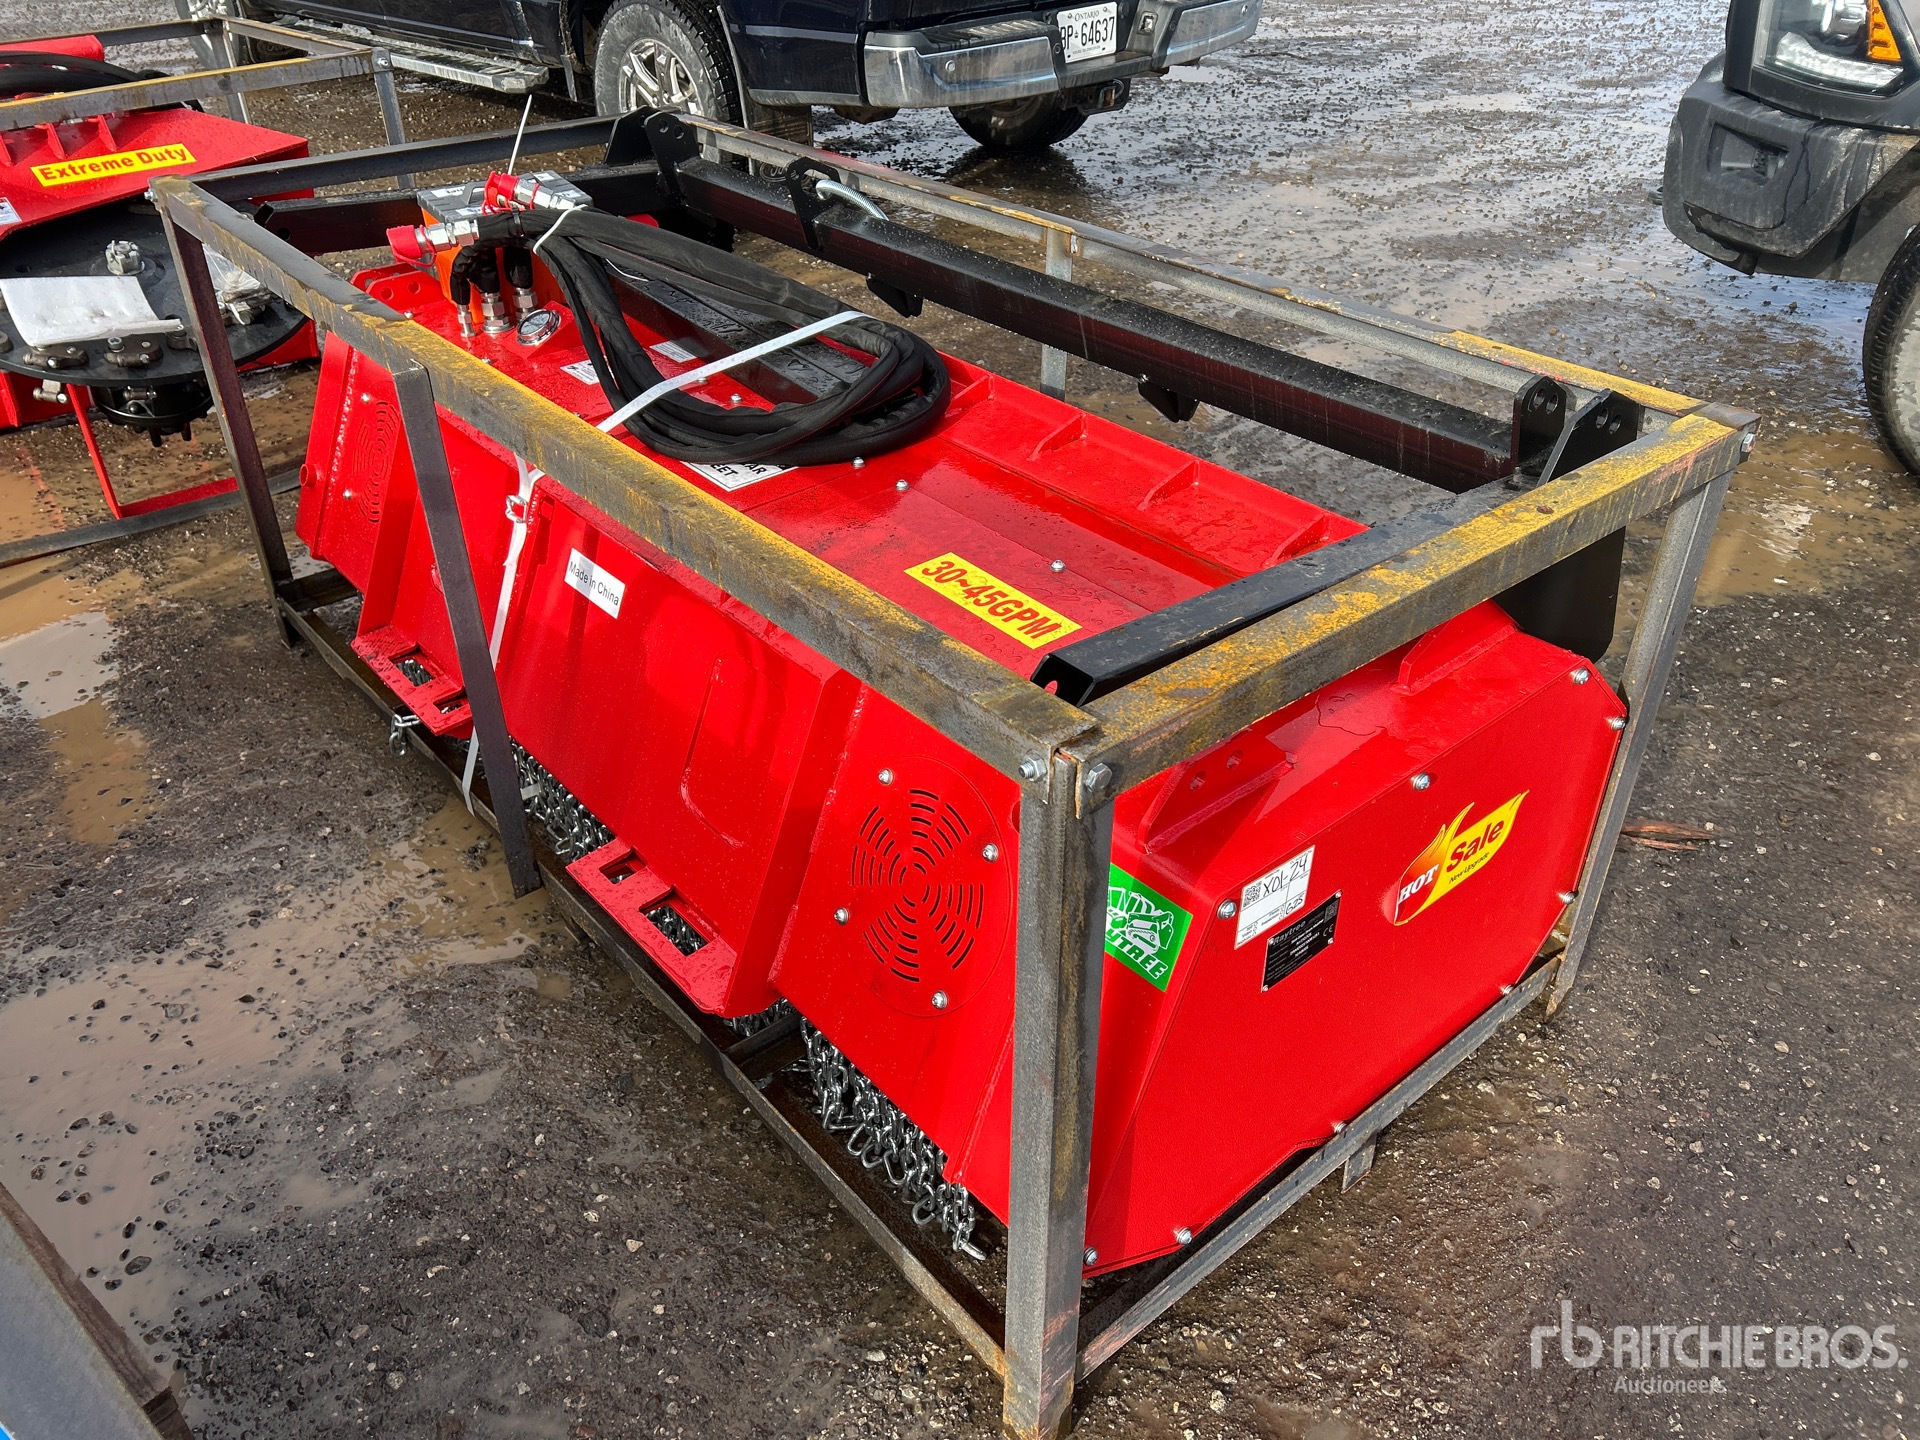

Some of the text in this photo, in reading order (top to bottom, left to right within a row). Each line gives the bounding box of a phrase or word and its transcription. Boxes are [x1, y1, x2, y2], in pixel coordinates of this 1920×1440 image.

[1081, 16, 1115, 46] 64637
[38, 148, 187, 181] Extreme Duty
[568, 561, 619, 606] Made in China
[1446, 820, 1505, 873] Sale
[1398, 863, 1440, 905] HOT
